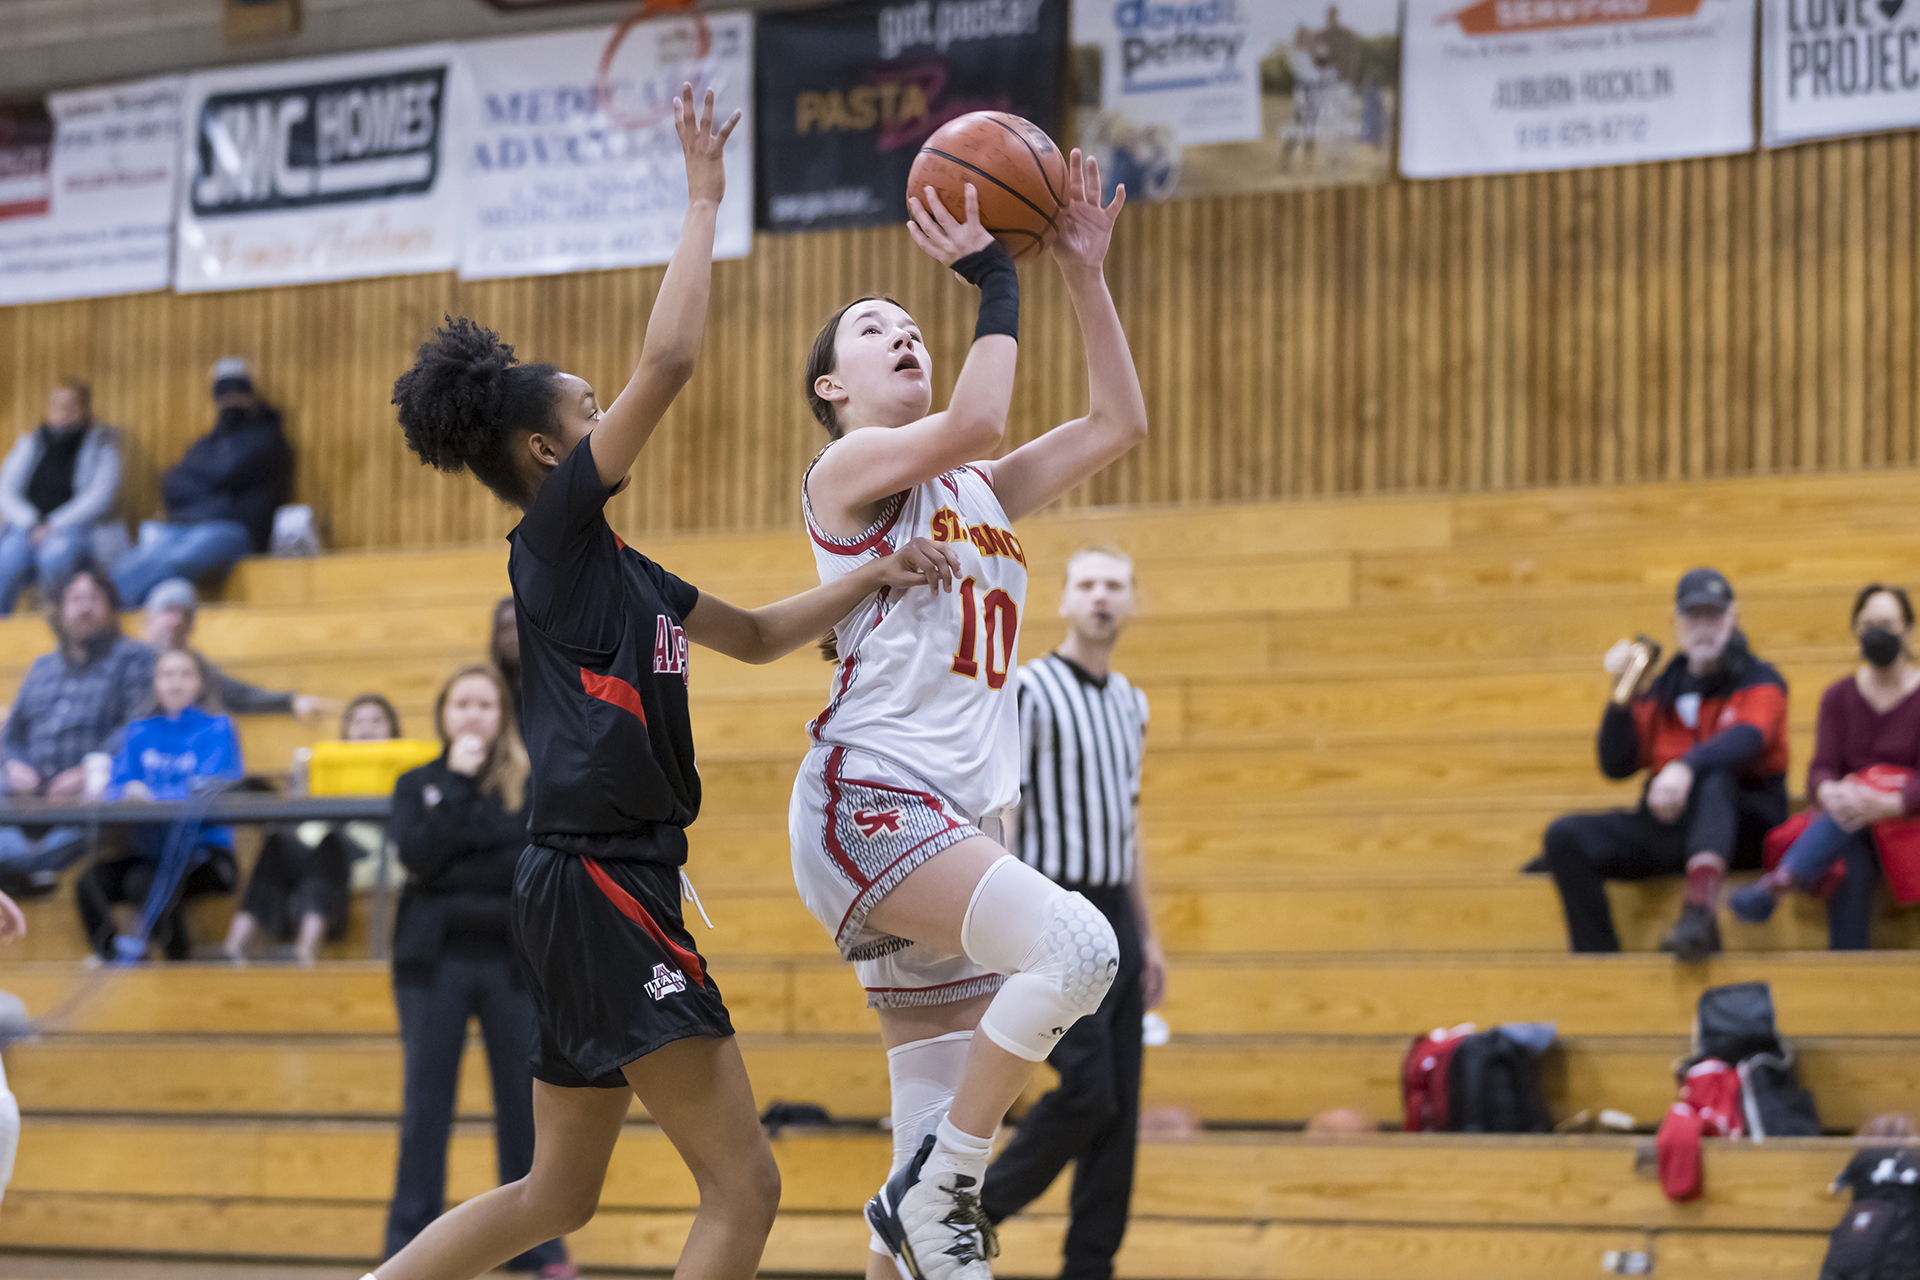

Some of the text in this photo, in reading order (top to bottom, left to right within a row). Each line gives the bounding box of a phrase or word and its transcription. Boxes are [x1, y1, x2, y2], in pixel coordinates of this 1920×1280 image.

[316, 80, 438, 163] HOMES
[796, 80, 929, 135] PASTA
[950, 575, 1018, 691] 10
